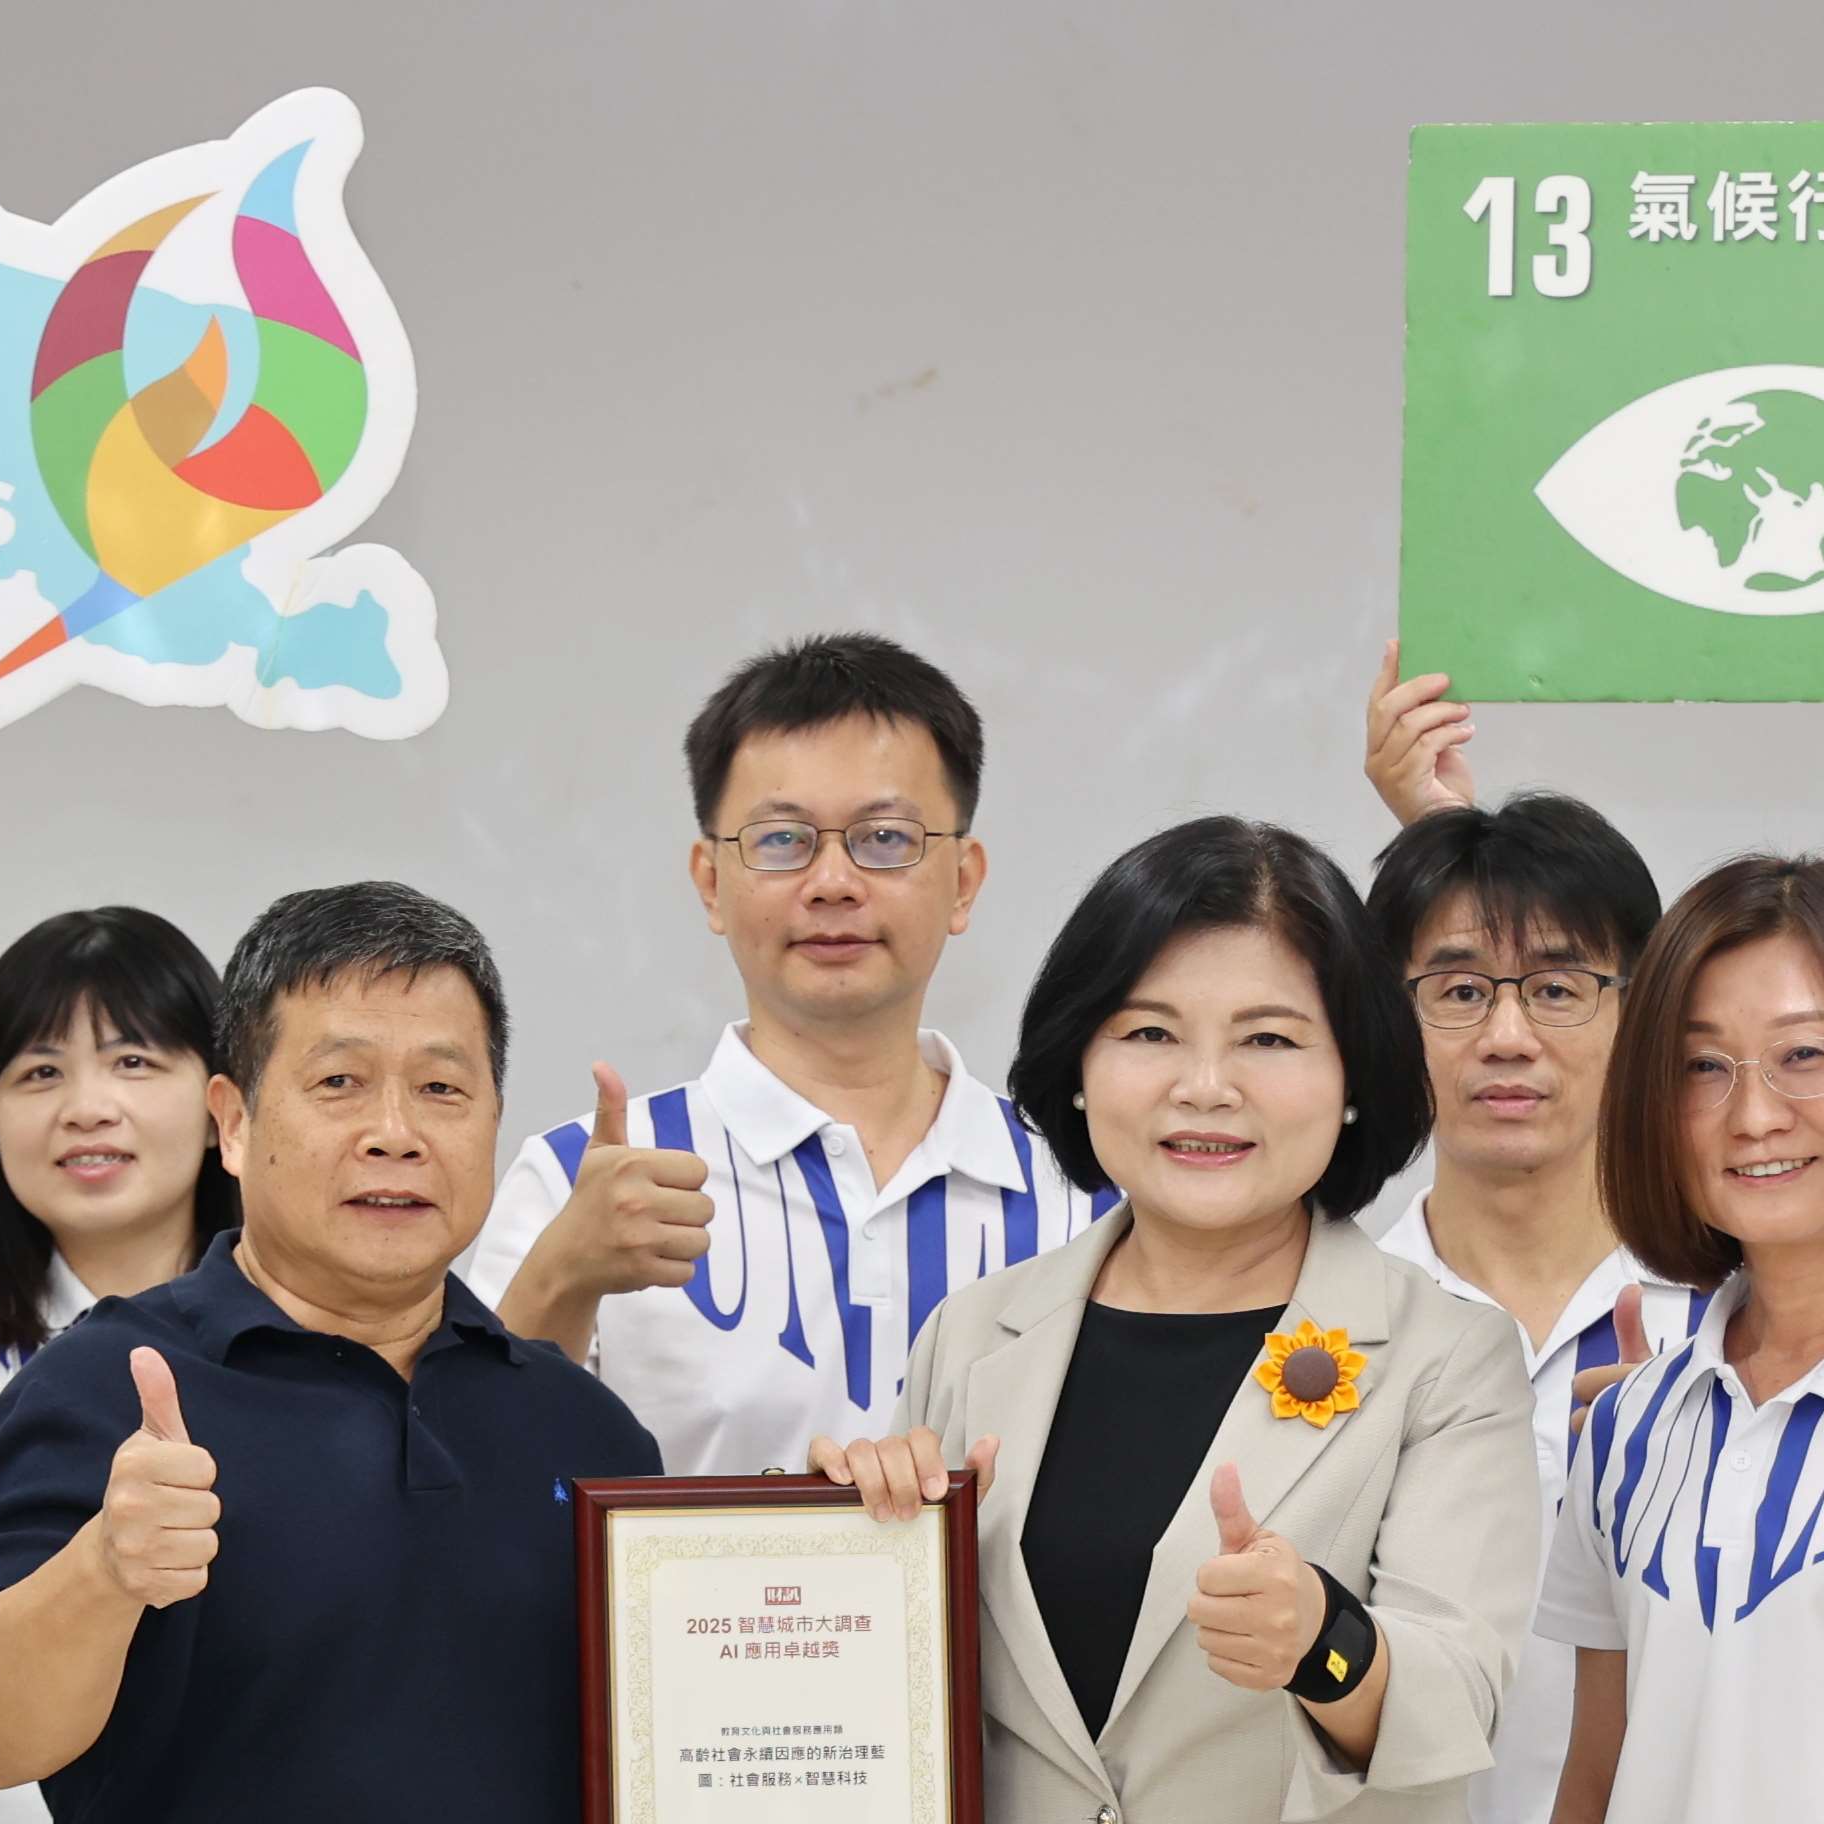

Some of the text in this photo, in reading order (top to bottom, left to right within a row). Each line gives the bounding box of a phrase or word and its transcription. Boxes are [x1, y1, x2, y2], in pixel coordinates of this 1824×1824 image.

[1462, 175, 1592, 298] 13
[686, 1614, 872, 1635] 2025 智慧城市大調查
[719, 1640, 841, 1660] AI 應用卓越獎
[679, 1744, 887, 1763] 高齡社會永續因應的新治理藍
